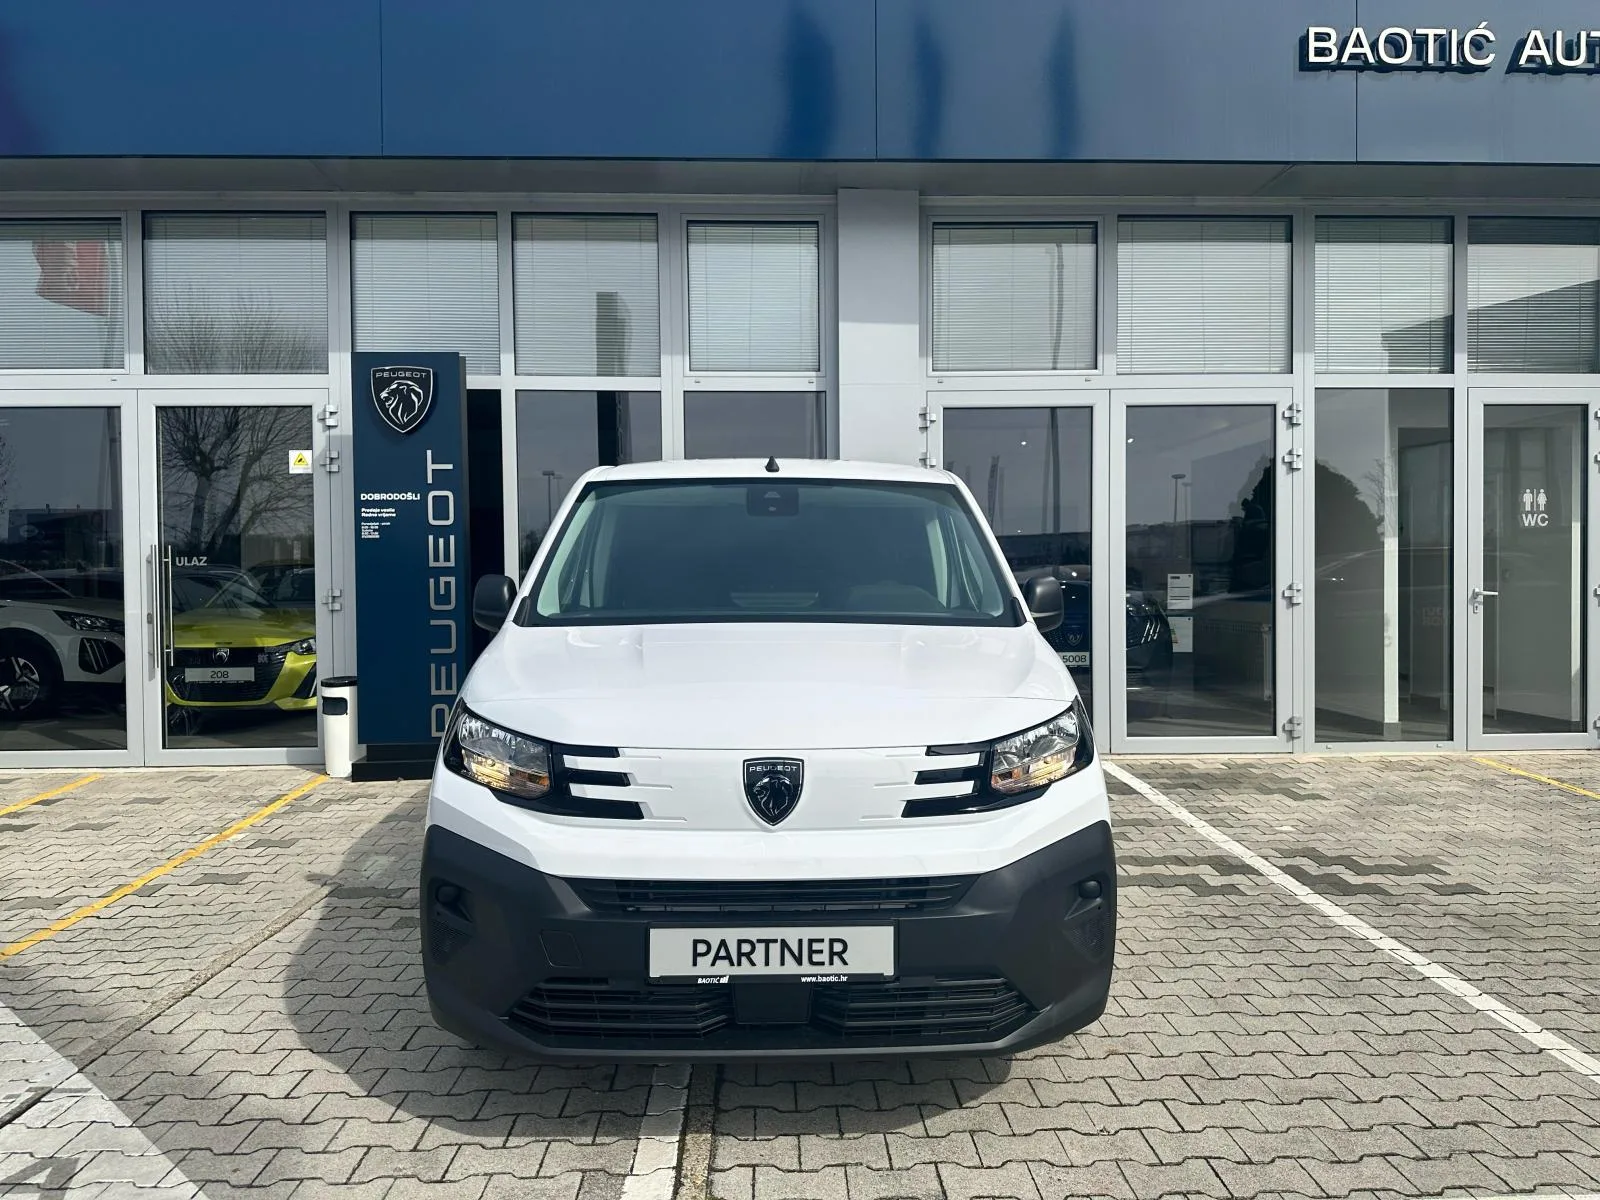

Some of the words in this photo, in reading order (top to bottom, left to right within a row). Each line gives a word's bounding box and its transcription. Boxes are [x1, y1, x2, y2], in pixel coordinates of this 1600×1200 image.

[1307, 21, 1496, 66] BAOTIĆ
[375, 371, 427, 379] PEUGEOT
[360, 492, 420, 501] DOBRODOŠLI
[1521, 513, 1549, 527] WC
[175, 556, 208, 567] ULAZ
[1062, 655, 1087, 663] 5008
[210, 670, 230, 679] 208
[749, 765, 798, 773] PEUGEOT
[691, 937, 849, 967] PARTNER
[800, 975, 848, 983] www.baotic.hr
